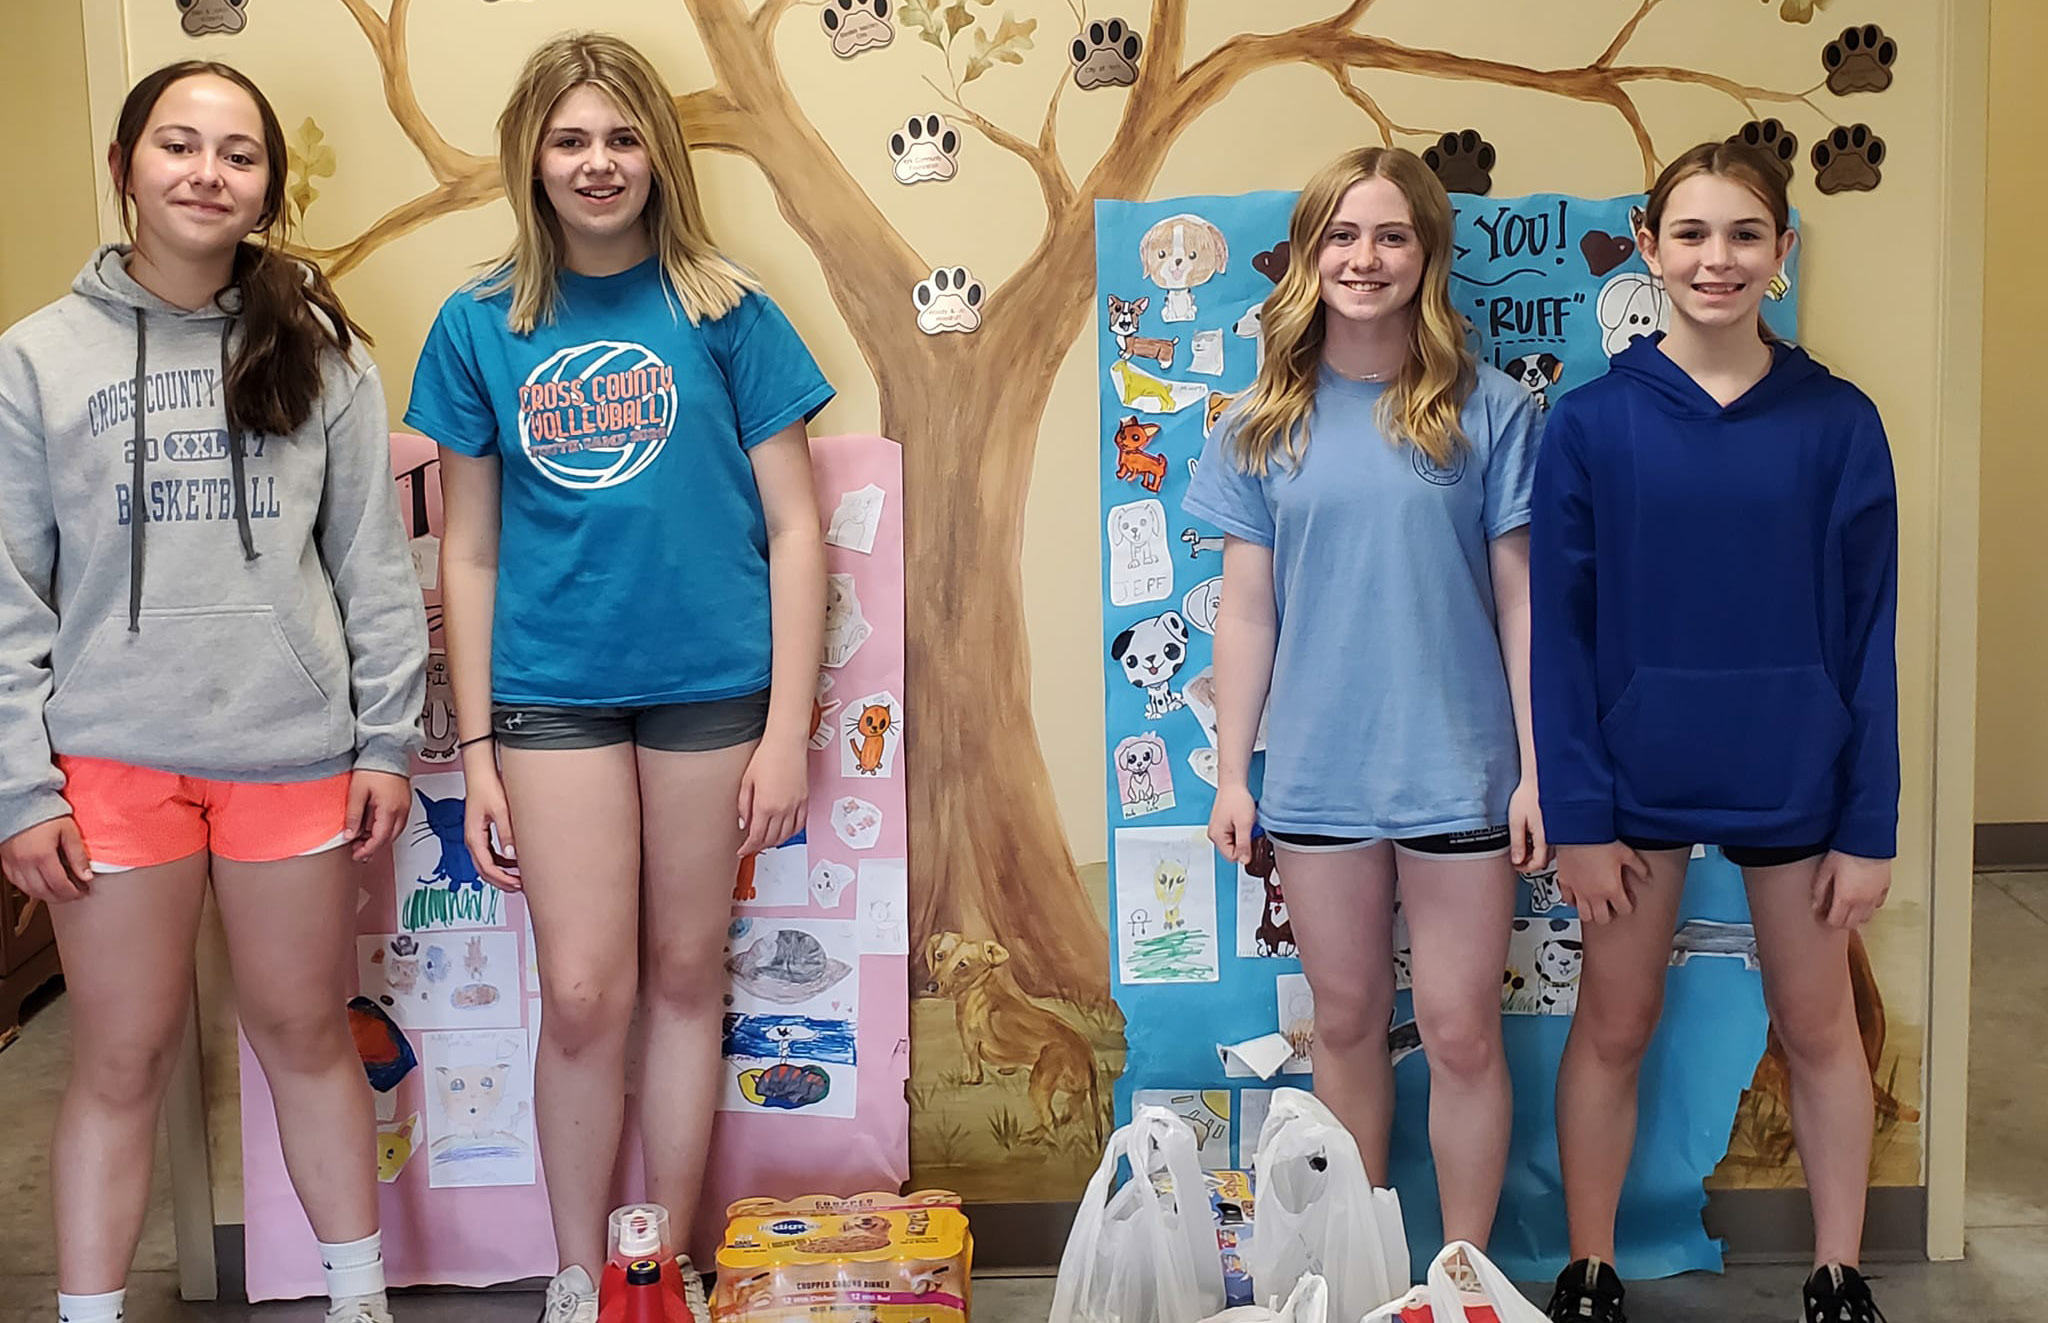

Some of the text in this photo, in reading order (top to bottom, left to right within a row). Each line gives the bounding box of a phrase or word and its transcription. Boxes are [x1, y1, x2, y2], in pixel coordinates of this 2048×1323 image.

[1473, 200, 1567, 265] YOU!
[87, 368, 216, 437] CROSS COUNTY
[519, 365, 674, 413] CROSS COUNTY
[531, 396, 664, 442] VOLLEYBALL
[171, 431, 227, 460] XXL
[115, 476, 281, 526] BSKETBLL
[797, 1281, 830, 1291] CHOPPED
